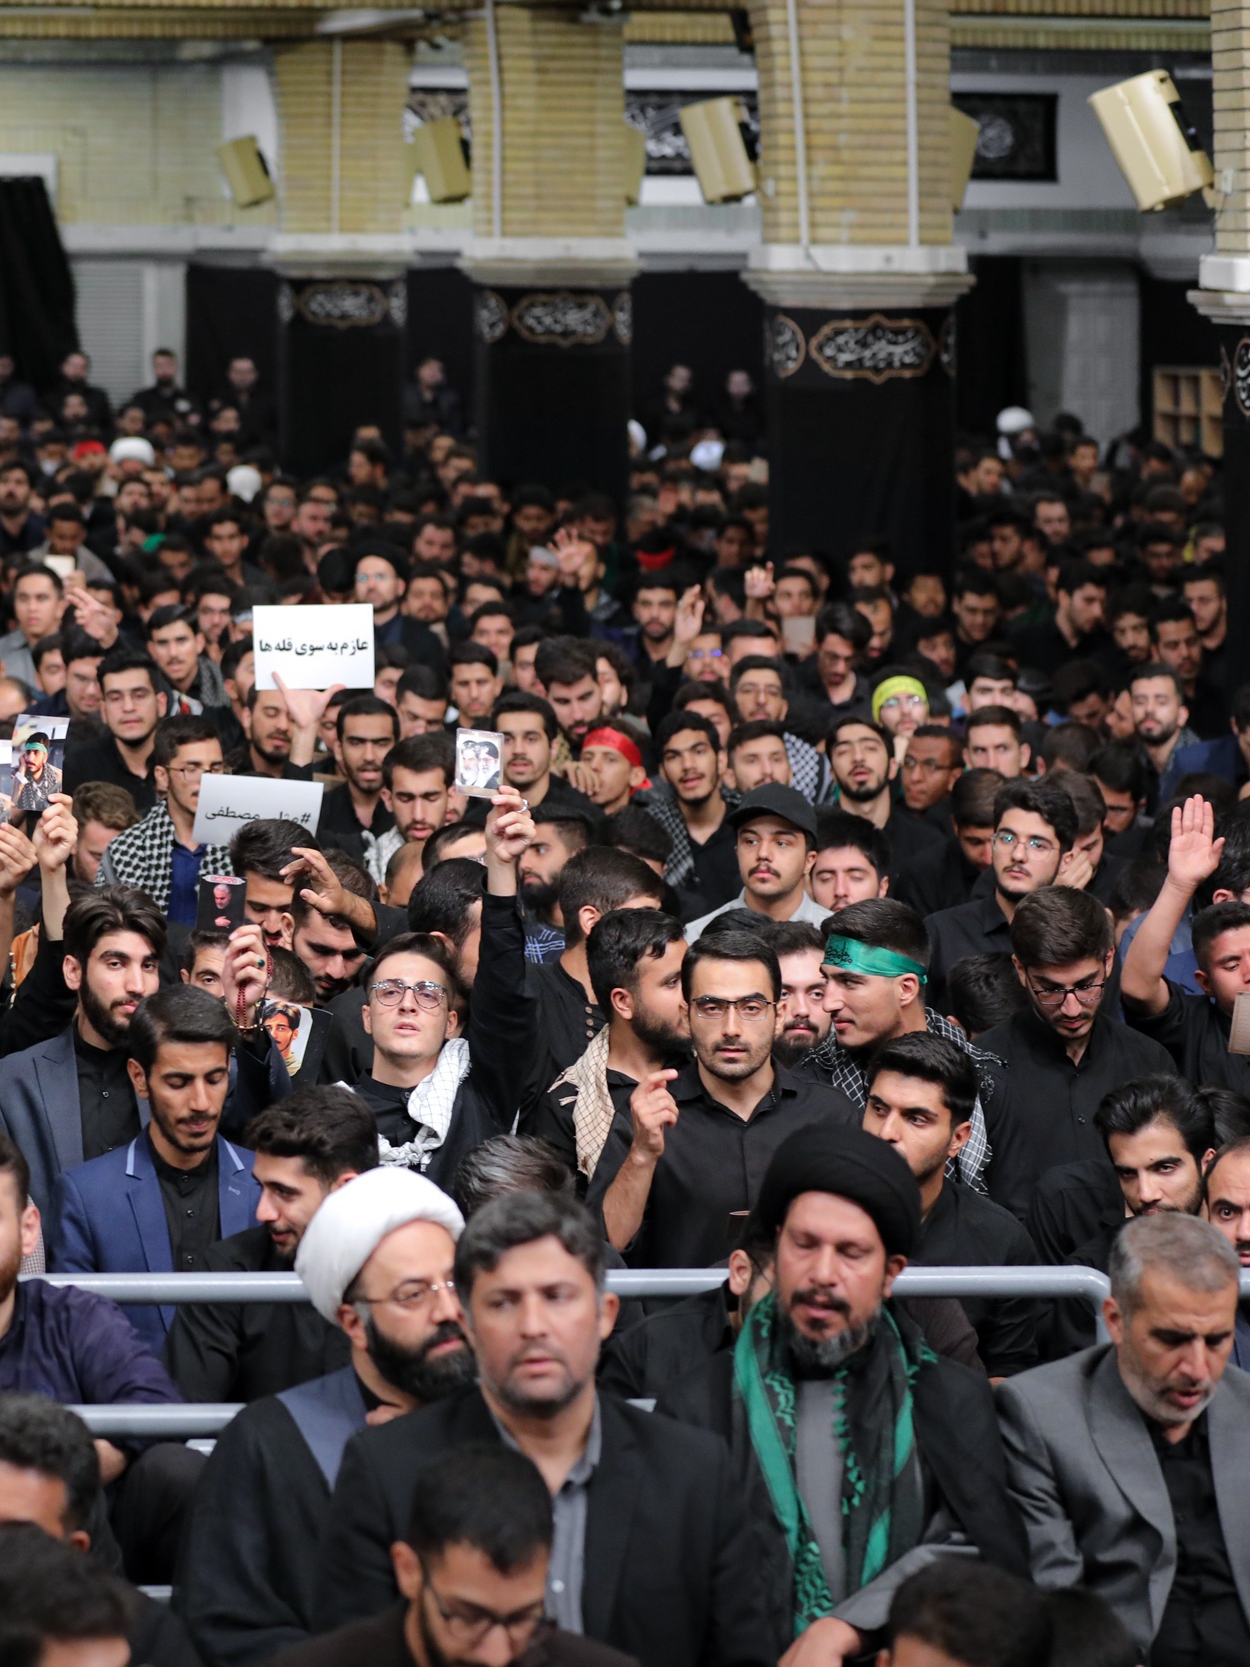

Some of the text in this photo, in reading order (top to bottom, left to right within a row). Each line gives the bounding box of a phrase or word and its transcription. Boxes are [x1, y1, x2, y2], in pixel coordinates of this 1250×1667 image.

[259, 637, 368, 657] عازم به سوی قله ها
